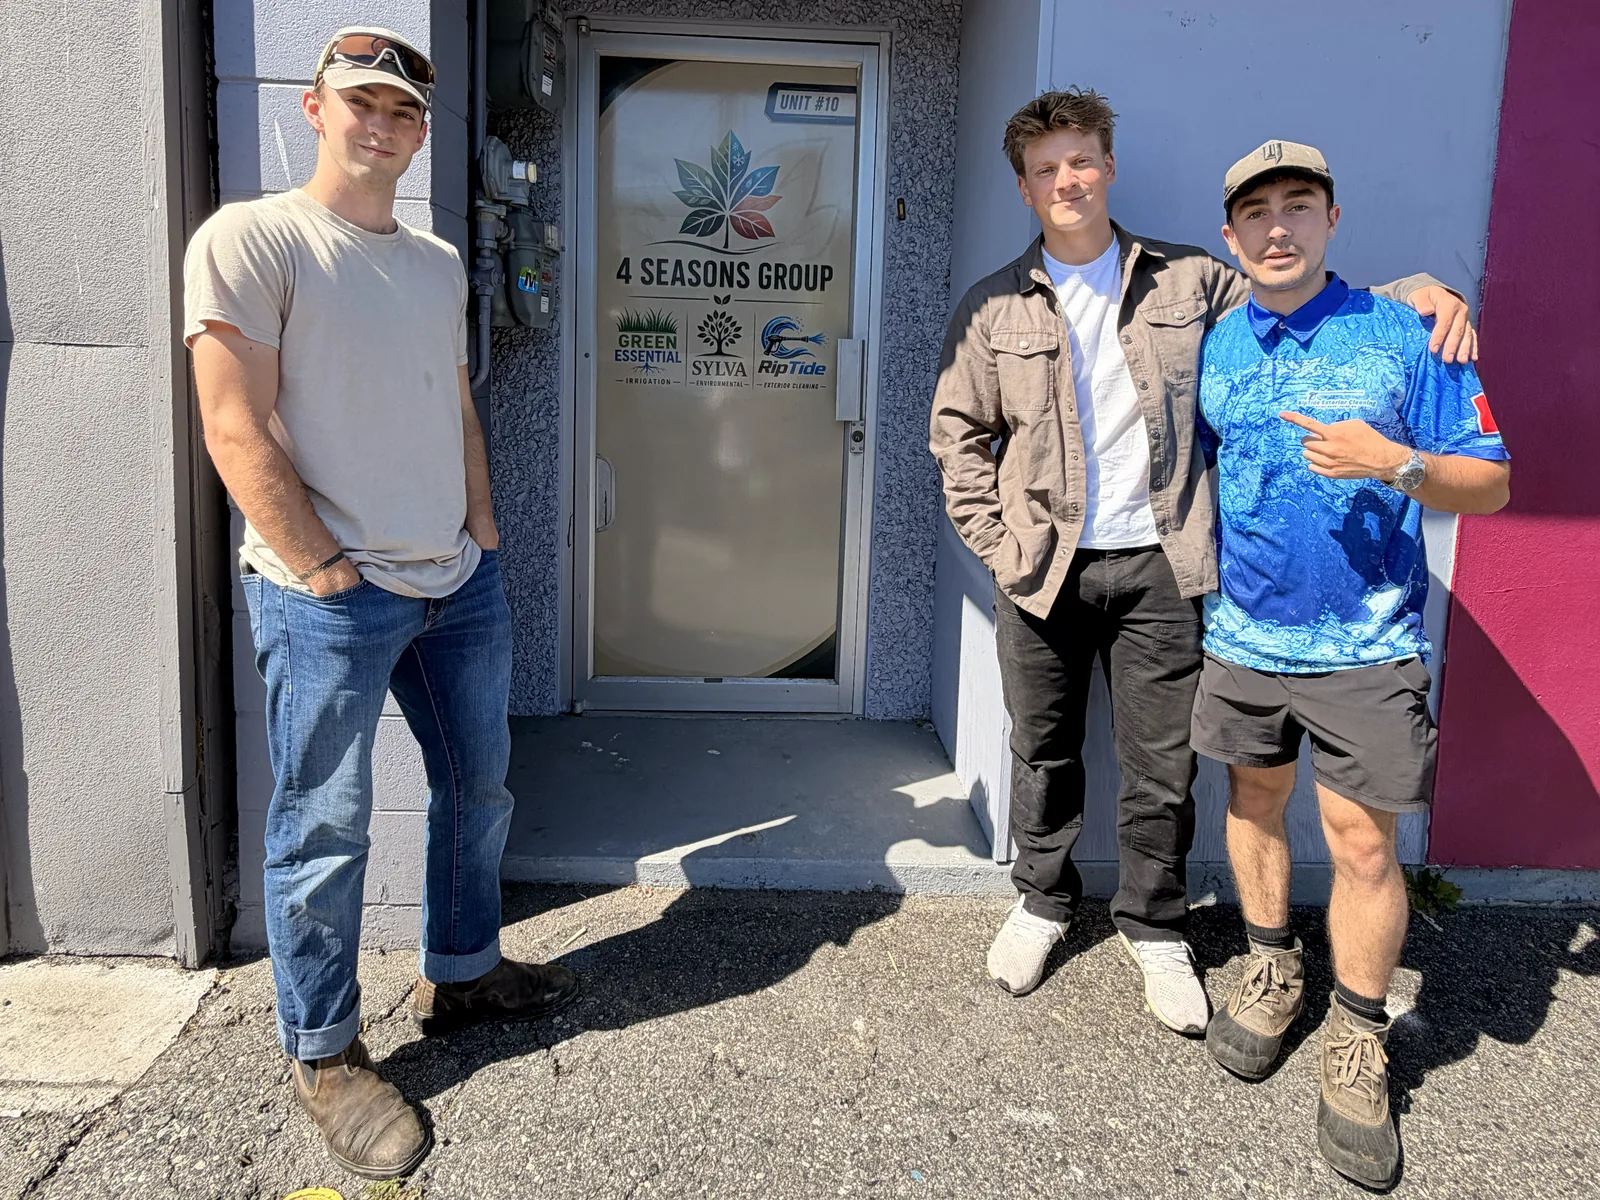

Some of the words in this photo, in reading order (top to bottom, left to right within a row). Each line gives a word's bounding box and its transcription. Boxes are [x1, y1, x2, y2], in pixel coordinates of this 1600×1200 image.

[779, 94, 812, 111] UNIT
[814, 96, 840, 112] #10
[616, 257, 632, 284] 4
[640, 257, 750, 289] SEASONS
[758, 262, 834, 292] GROUP
[618, 334, 677, 350] GREEN
[614, 350, 682, 364] ESSENTIAL
[691, 360, 747, 377] SYLVA
[757, 360, 827, 377] RipTide
[625, 377, 671, 385] IRRIGATION
[696, 380, 743, 388] ENVIRONMENTAL
[1348, 399, 1377, 407] Cleaning
